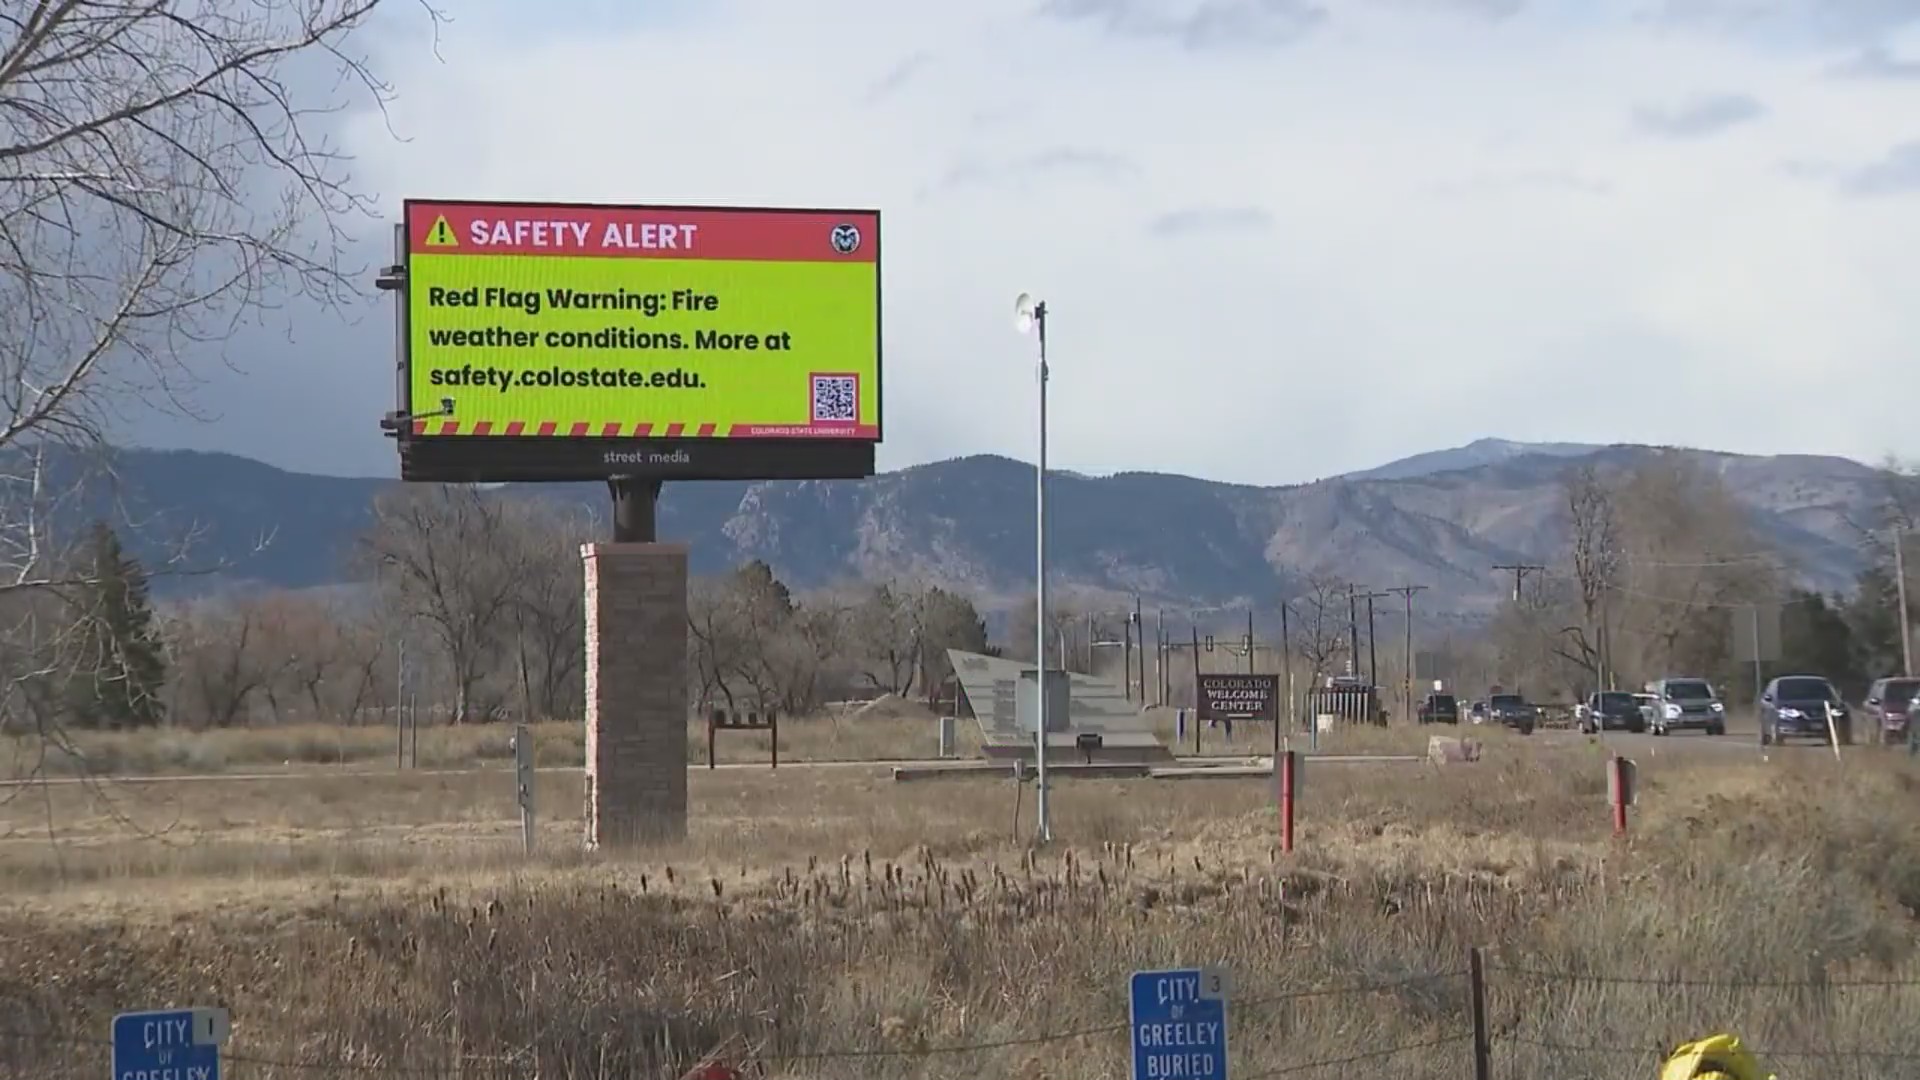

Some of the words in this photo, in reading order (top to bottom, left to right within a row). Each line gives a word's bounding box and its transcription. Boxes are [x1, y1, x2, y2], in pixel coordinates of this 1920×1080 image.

[470, 219, 592, 247] SAFETY
[601, 222, 698, 249] ALERT
[429, 286, 479, 308] Red
[485, 287, 541, 315] Flag
[546, 287, 667, 317] Warning:
[672, 289, 719, 310] Fire
[429, 326, 539, 347] weather
[545, 327, 689, 349] conditions.
[695, 330, 759, 350] More
[764, 331, 791, 351] at
[430, 364, 706, 393] safety.colostate.edu.
[603, 450, 642, 463] street
[649, 449, 690, 463] media
[1203, 679, 1272, 689] COLORADO
[1207, 689, 1268, 699] WELCOME
[1211, 700, 1263, 711] CENTER
[1157, 977, 1197, 1001] CITY
[1210, 975, 1221, 993] 3
[143, 1020, 187, 1045] CITY
[1140, 1022, 1218, 1047] GREELEY
[1147, 1053, 1214, 1077] BURIED
